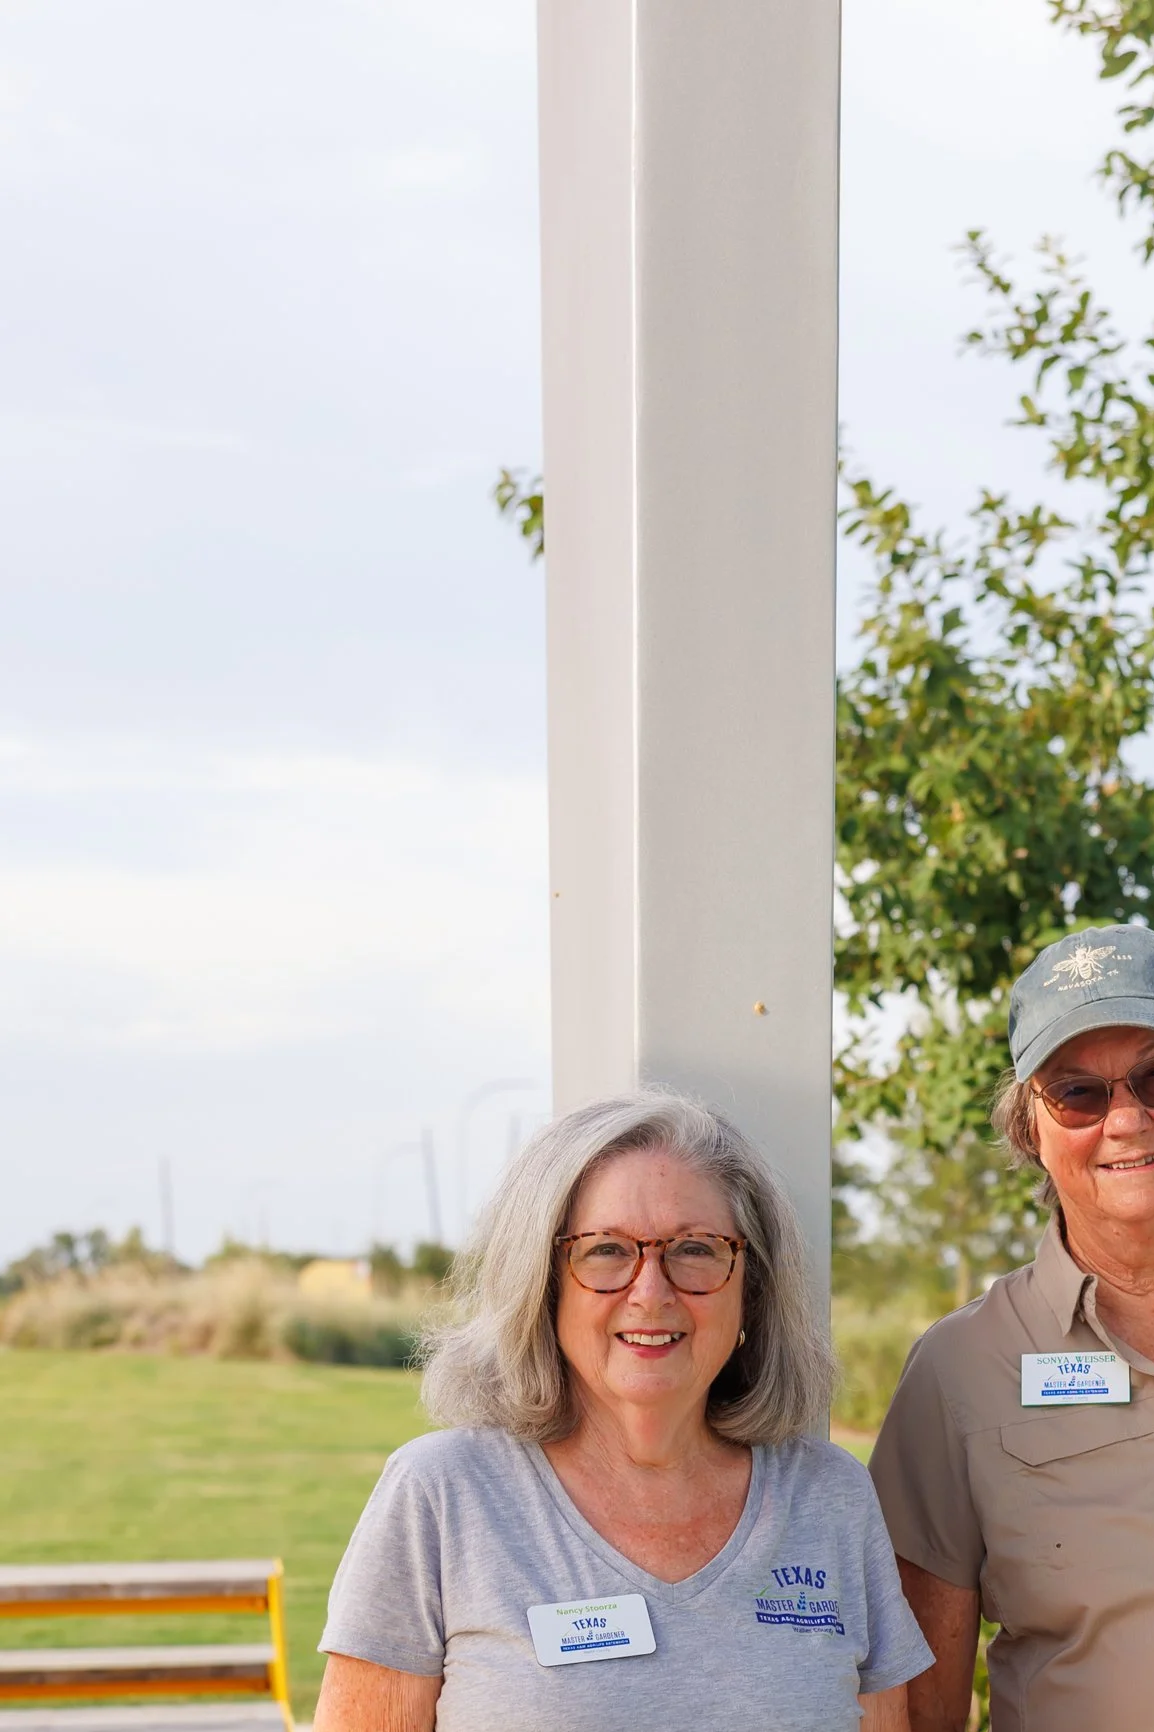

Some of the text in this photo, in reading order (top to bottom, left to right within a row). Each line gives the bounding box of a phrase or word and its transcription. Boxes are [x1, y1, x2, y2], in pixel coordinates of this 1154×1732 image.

[1037, 1355, 1116, 1364] SONYA WEISSER
[1058, 1364, 1090, 1374] TEXAS
[771, 1566, 826, 1589] TEXAS
[556, 1603, 617, 1616] Nancy Stoorza
[756, 1598, 794, 1612] MASTER
[572, 1617, 607, 1631] TEXAS
[562, 1630, 625, 1644] MASTER GARDENER
